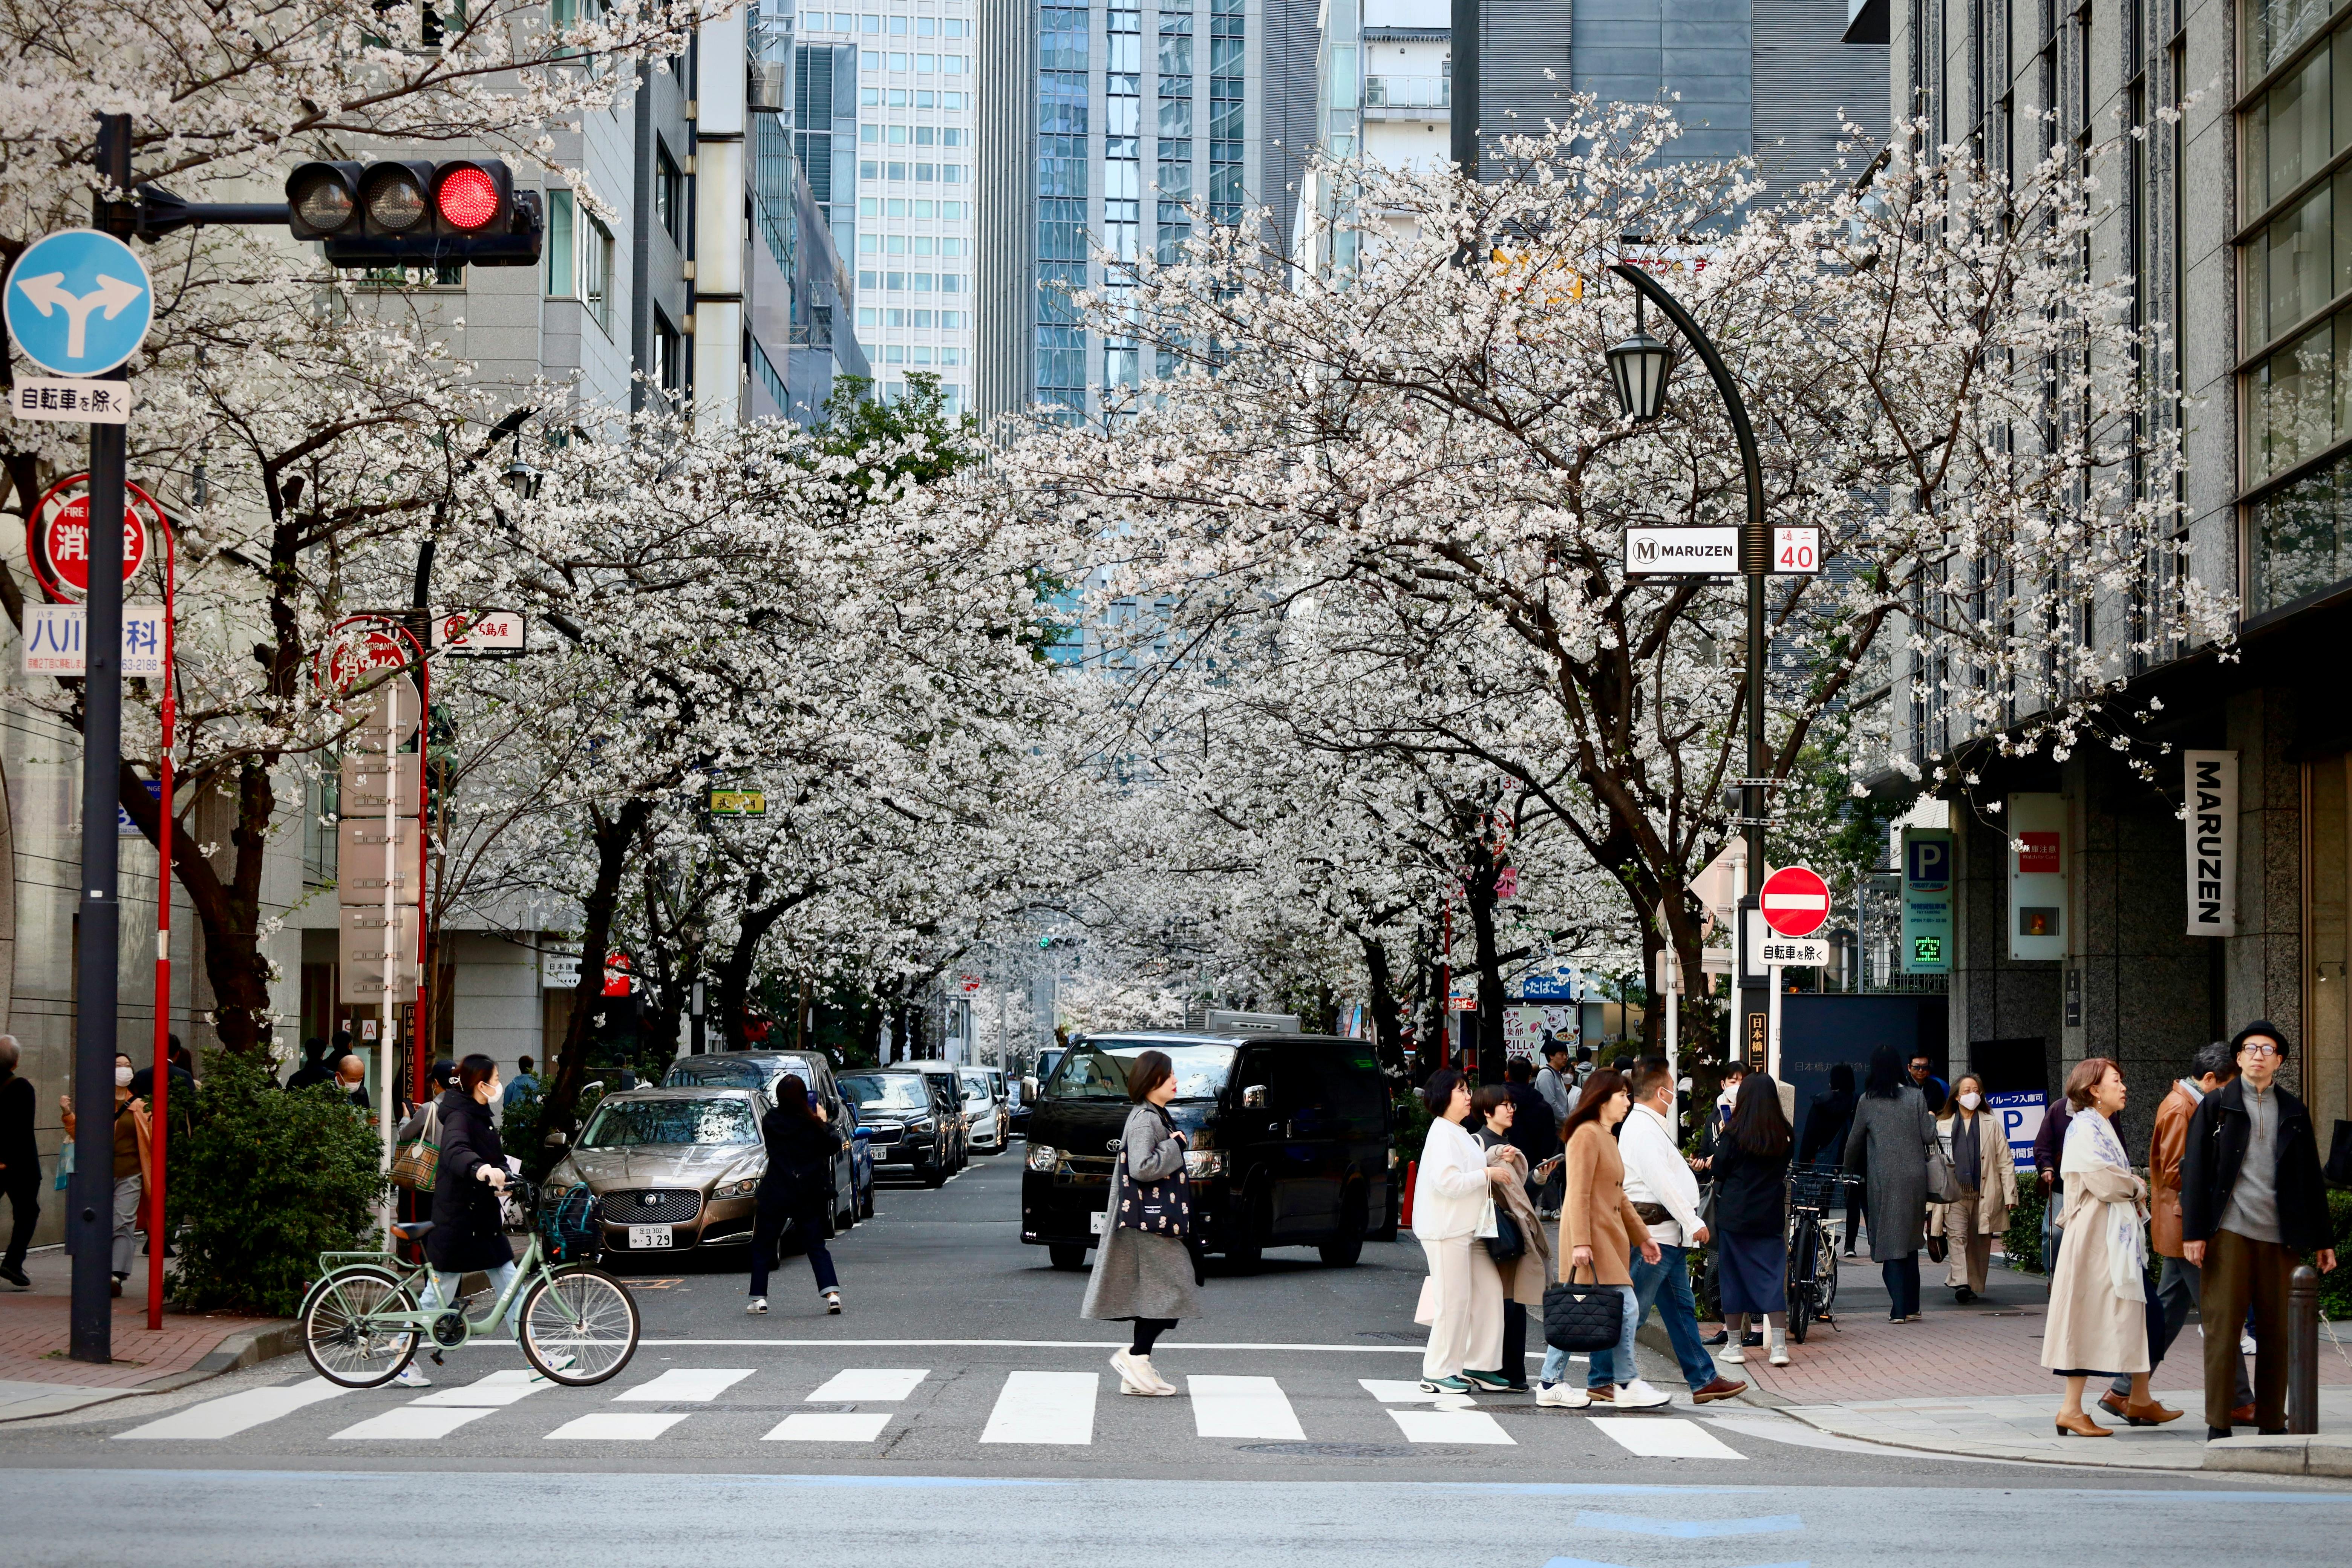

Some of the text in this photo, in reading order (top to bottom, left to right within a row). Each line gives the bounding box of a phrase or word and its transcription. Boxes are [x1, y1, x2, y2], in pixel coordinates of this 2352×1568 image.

[22, 387, 121, 413] 自転車を除く
[64, 507, 85, 517] FIRE
[1662, 546, 1733, 556] MARUZEN
[1780, 546, 1812, 567] 40
[29, 619, 157, 655] 八川科
[2196, 761, 2221, 923] MARUZEN
[1919, 844, 1941, 878] P
[1764, 945, 1822, 960] 自転車を除く
[1916, 937, 1940, 961] 空
[1529, 981, 1560, 994] たばこ
[1504, 1027, 1524, 1036] 楽部
[2003, 1110, 2023, 1139] P
